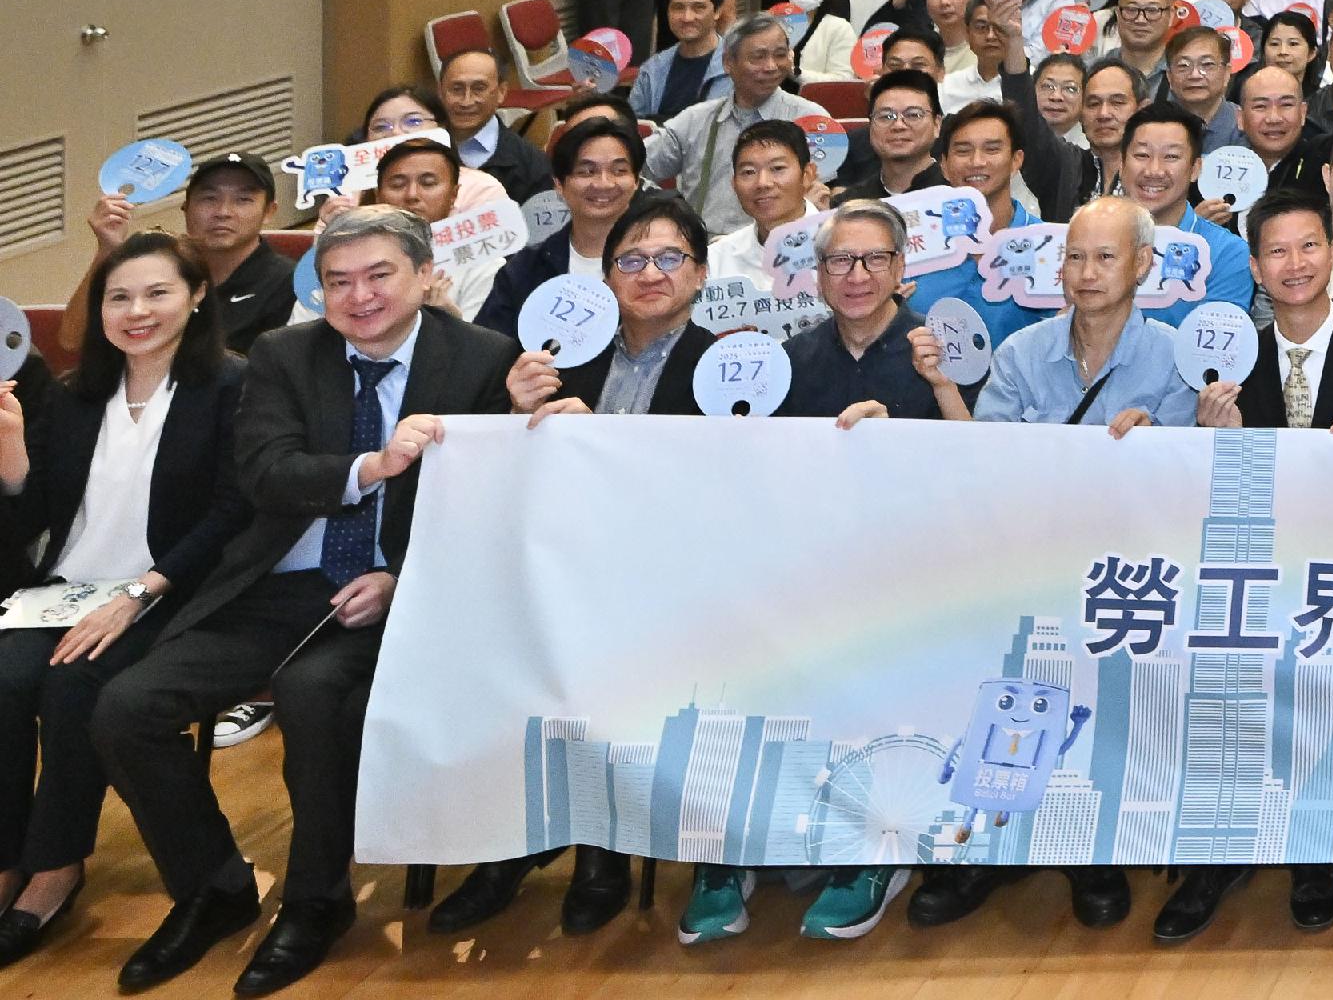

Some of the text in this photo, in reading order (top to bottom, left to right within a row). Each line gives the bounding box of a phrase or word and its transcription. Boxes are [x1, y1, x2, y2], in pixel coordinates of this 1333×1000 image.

[705, 302, 746, 322] 12.7
[974, 767, 1030, 793] 投票箱
